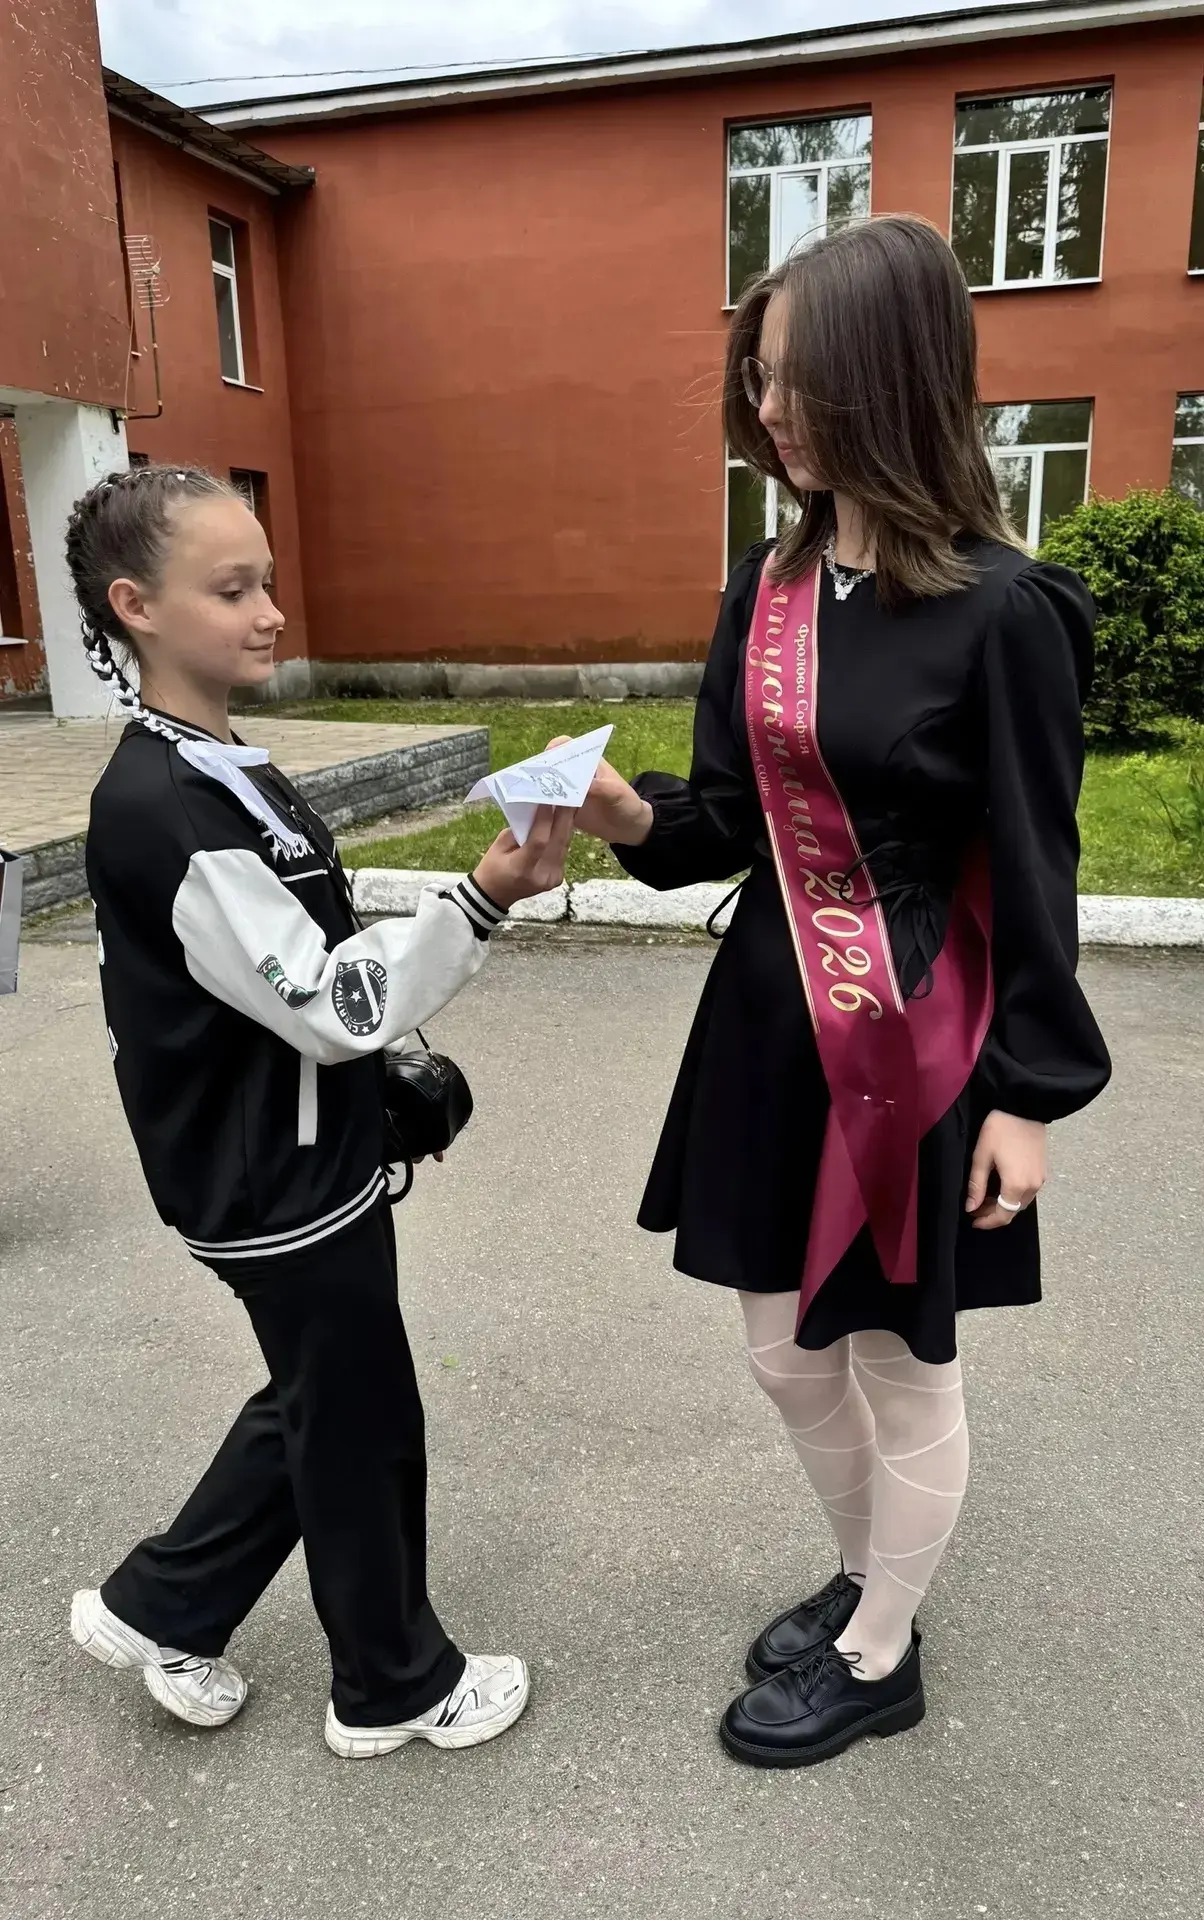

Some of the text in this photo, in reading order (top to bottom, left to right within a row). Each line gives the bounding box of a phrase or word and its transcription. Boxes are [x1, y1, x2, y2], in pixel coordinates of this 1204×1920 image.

[793, 623, 810, 755] Фролова София
[748, 582, 883, 1021] пускница 2026
[757, 764, 771, 797] СОШ»
